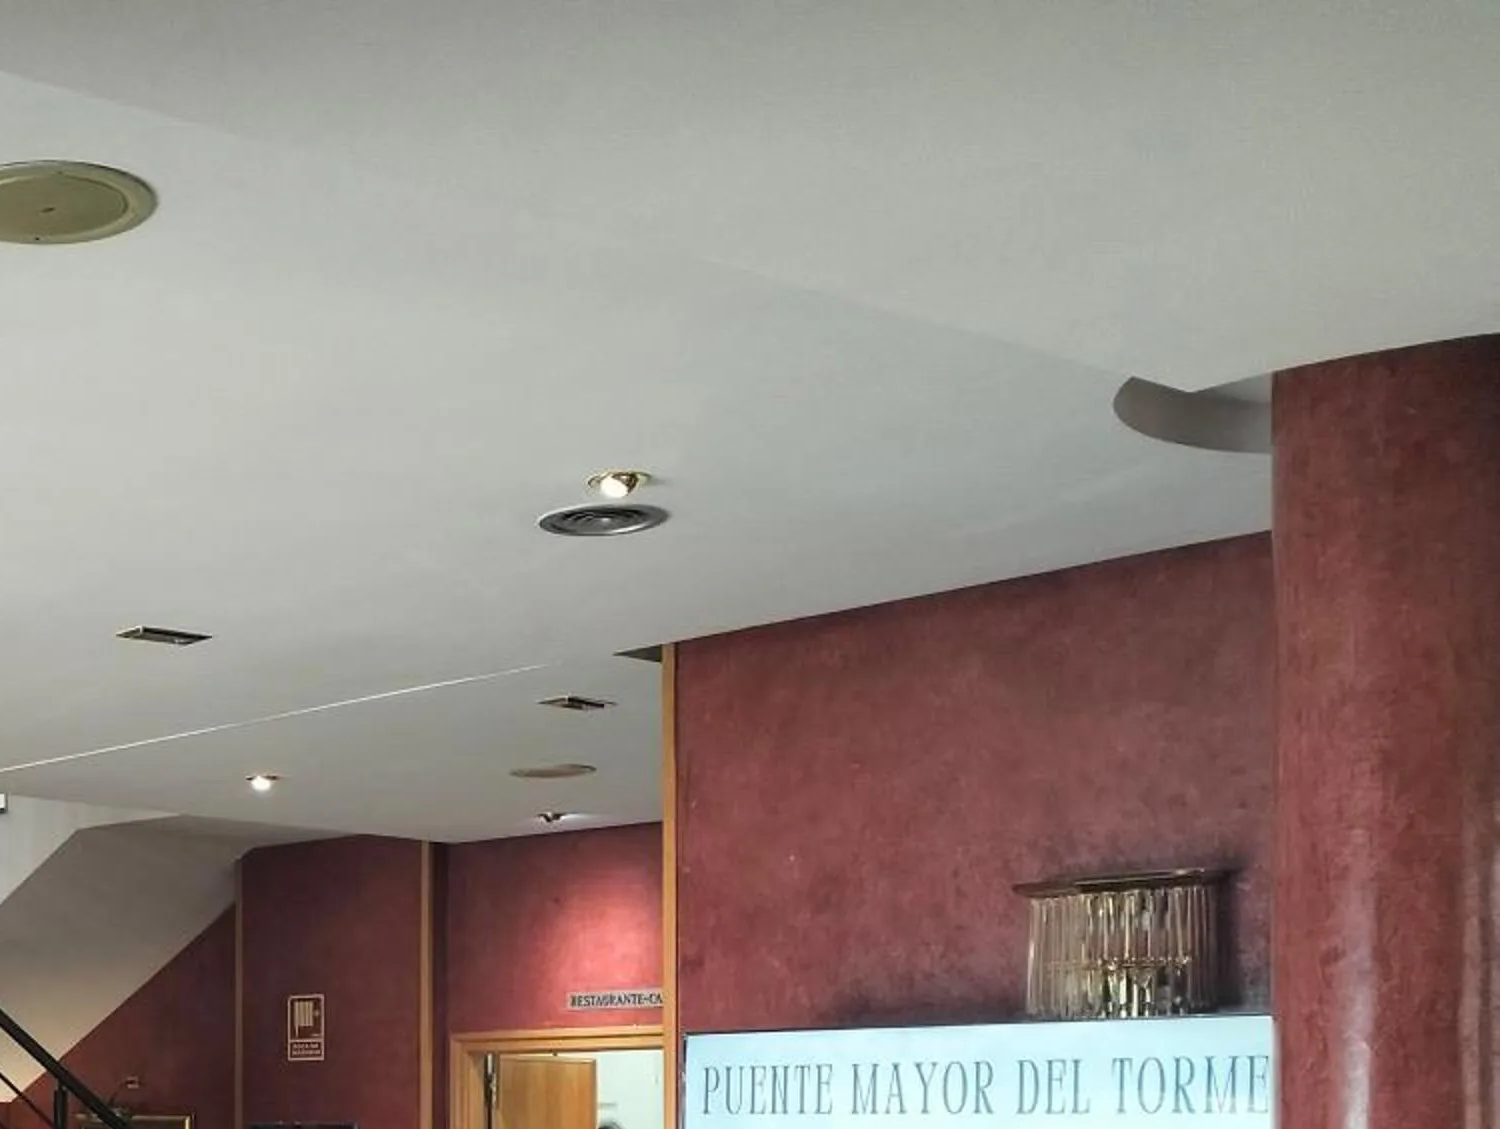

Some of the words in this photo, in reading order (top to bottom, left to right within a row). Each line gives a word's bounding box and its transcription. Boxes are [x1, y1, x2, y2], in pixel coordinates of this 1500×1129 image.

[702, 1063, 834, 1115] PUENTE
[851, 1060, 994, 1115] MAYOR
[1015, 1058, 1092, 1115] DEL
